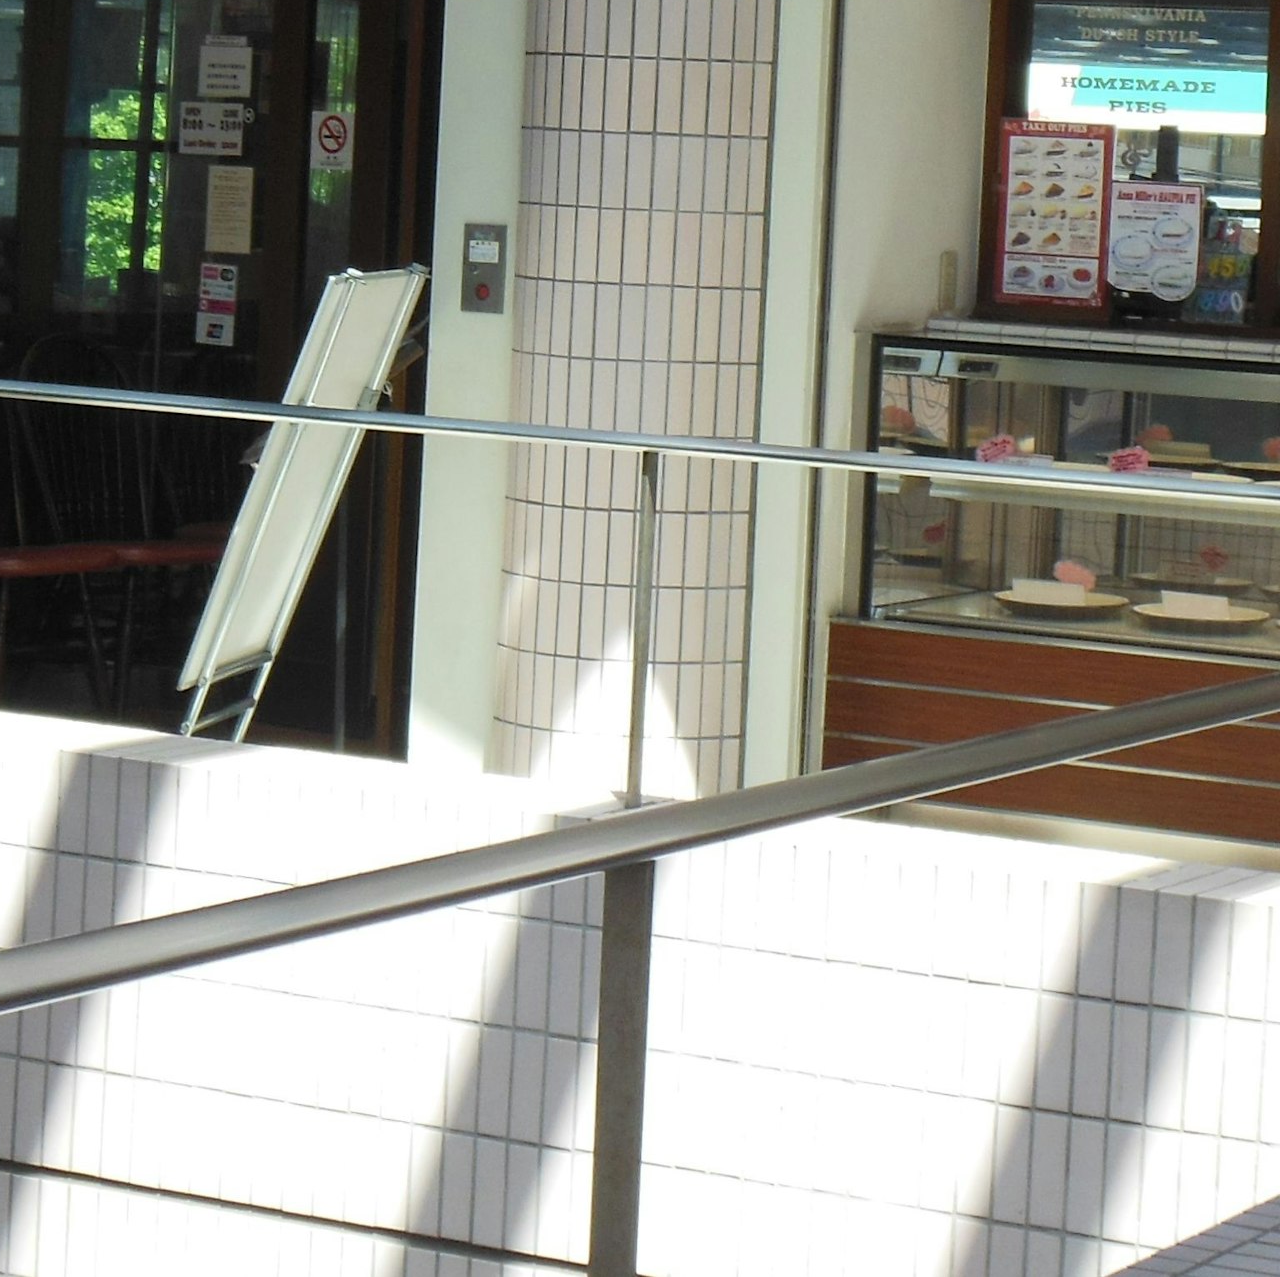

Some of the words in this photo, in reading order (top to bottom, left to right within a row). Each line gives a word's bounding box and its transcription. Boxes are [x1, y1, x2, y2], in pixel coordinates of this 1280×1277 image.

[1076, 6, 1207, 23] PENNSYLVANIA
[1080, 27, 1139, 42] DUTCH
[1144, 29, 1201, 44] STYLE
[1061, 75, 1217, 95] HOMEMADE
[1109, 99, 1168, 115] PIES
[1022, 121, 1046, 132] TAKE
[1047, 123, 1067, 133] OUT
